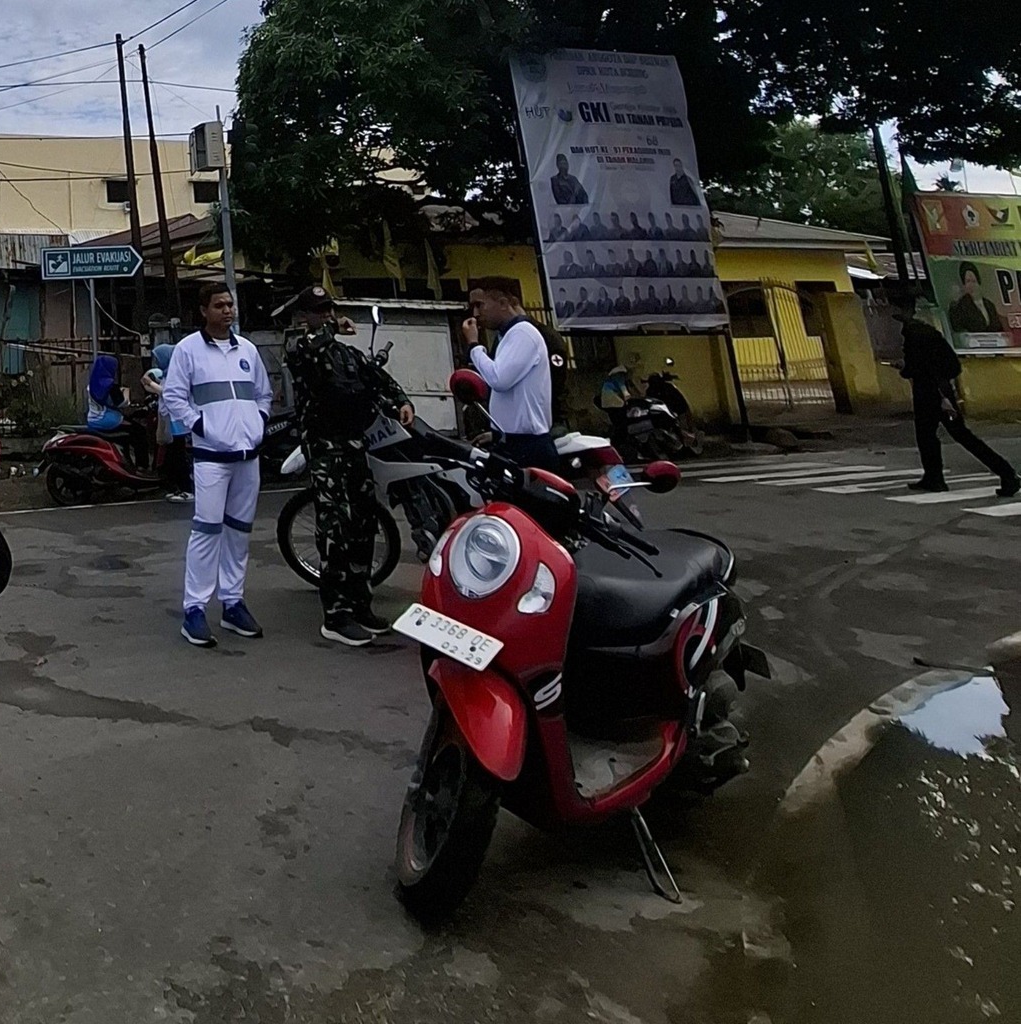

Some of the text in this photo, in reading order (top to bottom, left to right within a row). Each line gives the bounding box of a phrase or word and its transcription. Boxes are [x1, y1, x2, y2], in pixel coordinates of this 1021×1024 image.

[525, 105, 550, 120] HUT
[578, 101, 611, 123] GKI
[72, 251, 131, 264] JALUR EVAKUASI
[409, 607, 430, 622] PB
[431, 617, 468, 640] 3368
